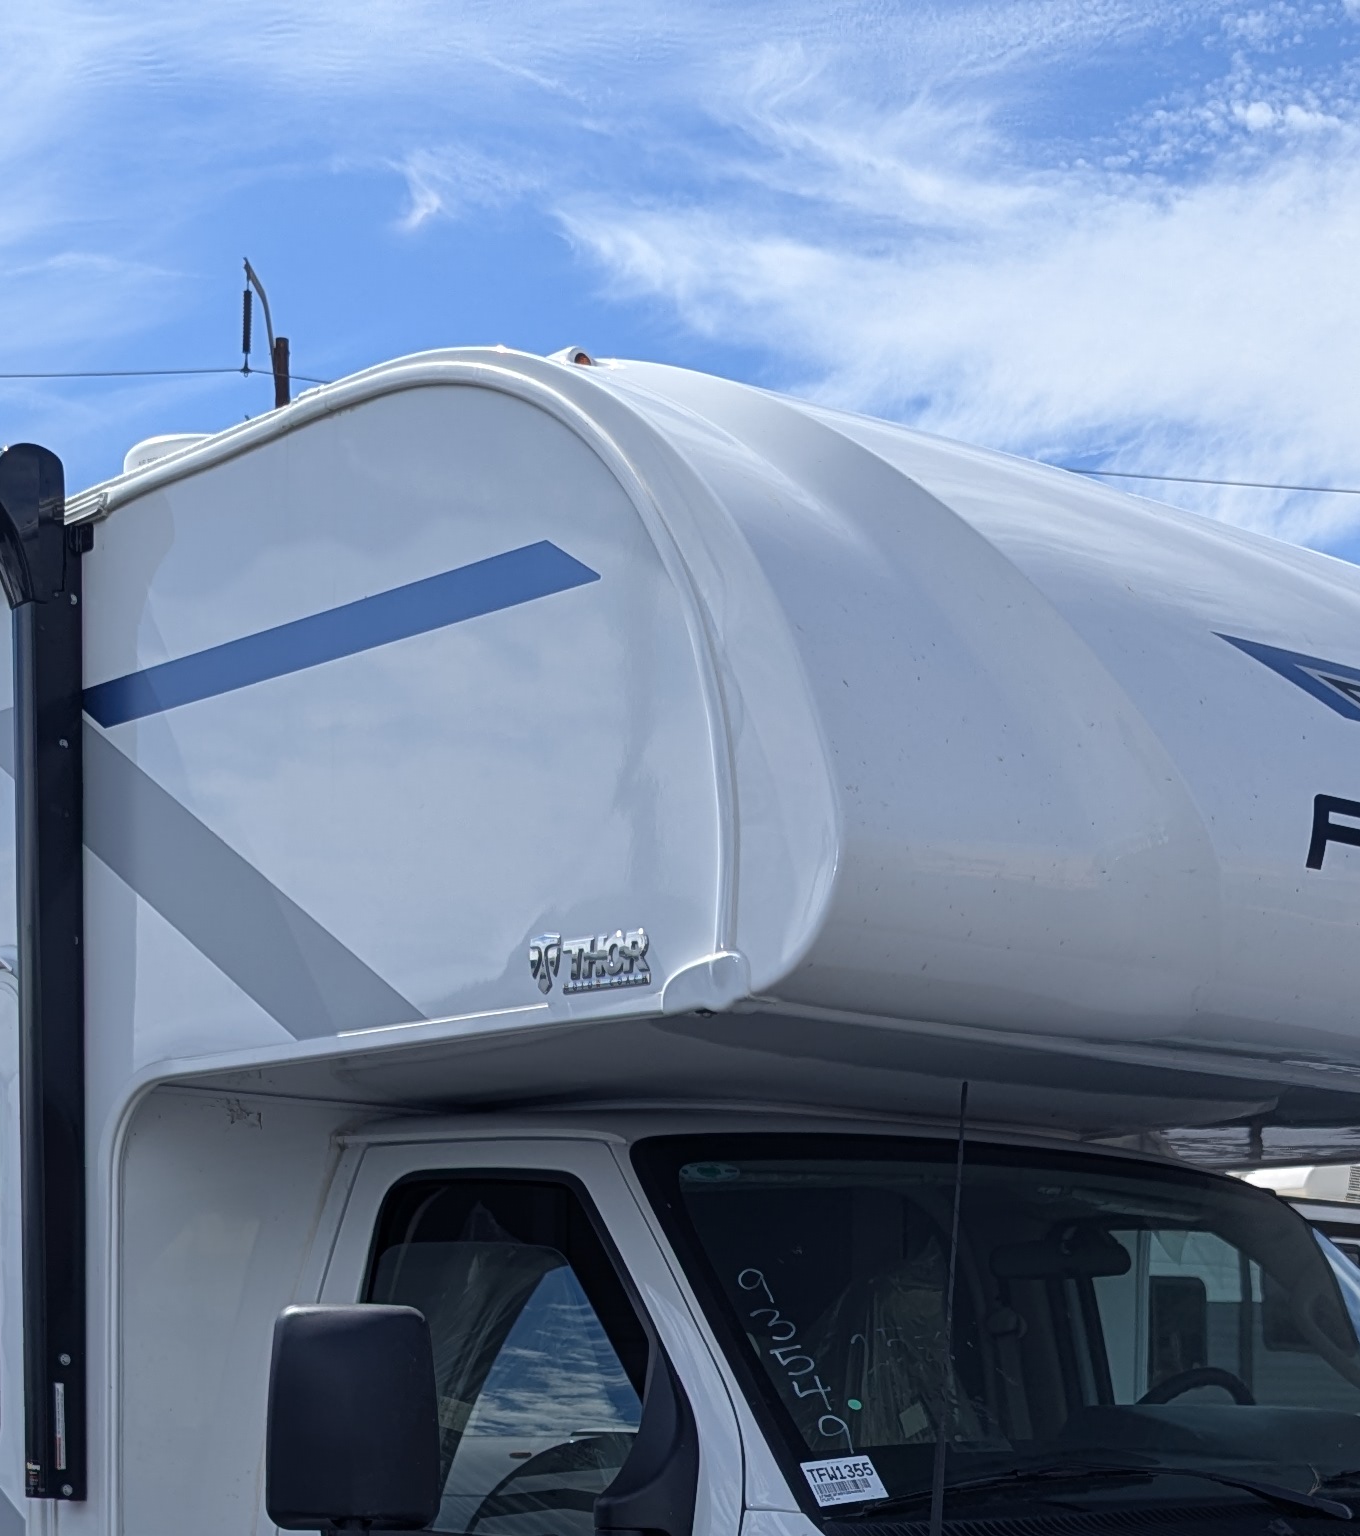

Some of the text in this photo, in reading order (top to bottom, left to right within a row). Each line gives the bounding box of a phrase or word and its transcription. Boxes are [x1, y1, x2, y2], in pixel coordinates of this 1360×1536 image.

[563, 927, 650, 980] THOR
[737, 1267, 854, 1455] 93549
[806, 1462, 874, 1484] TFW1355
